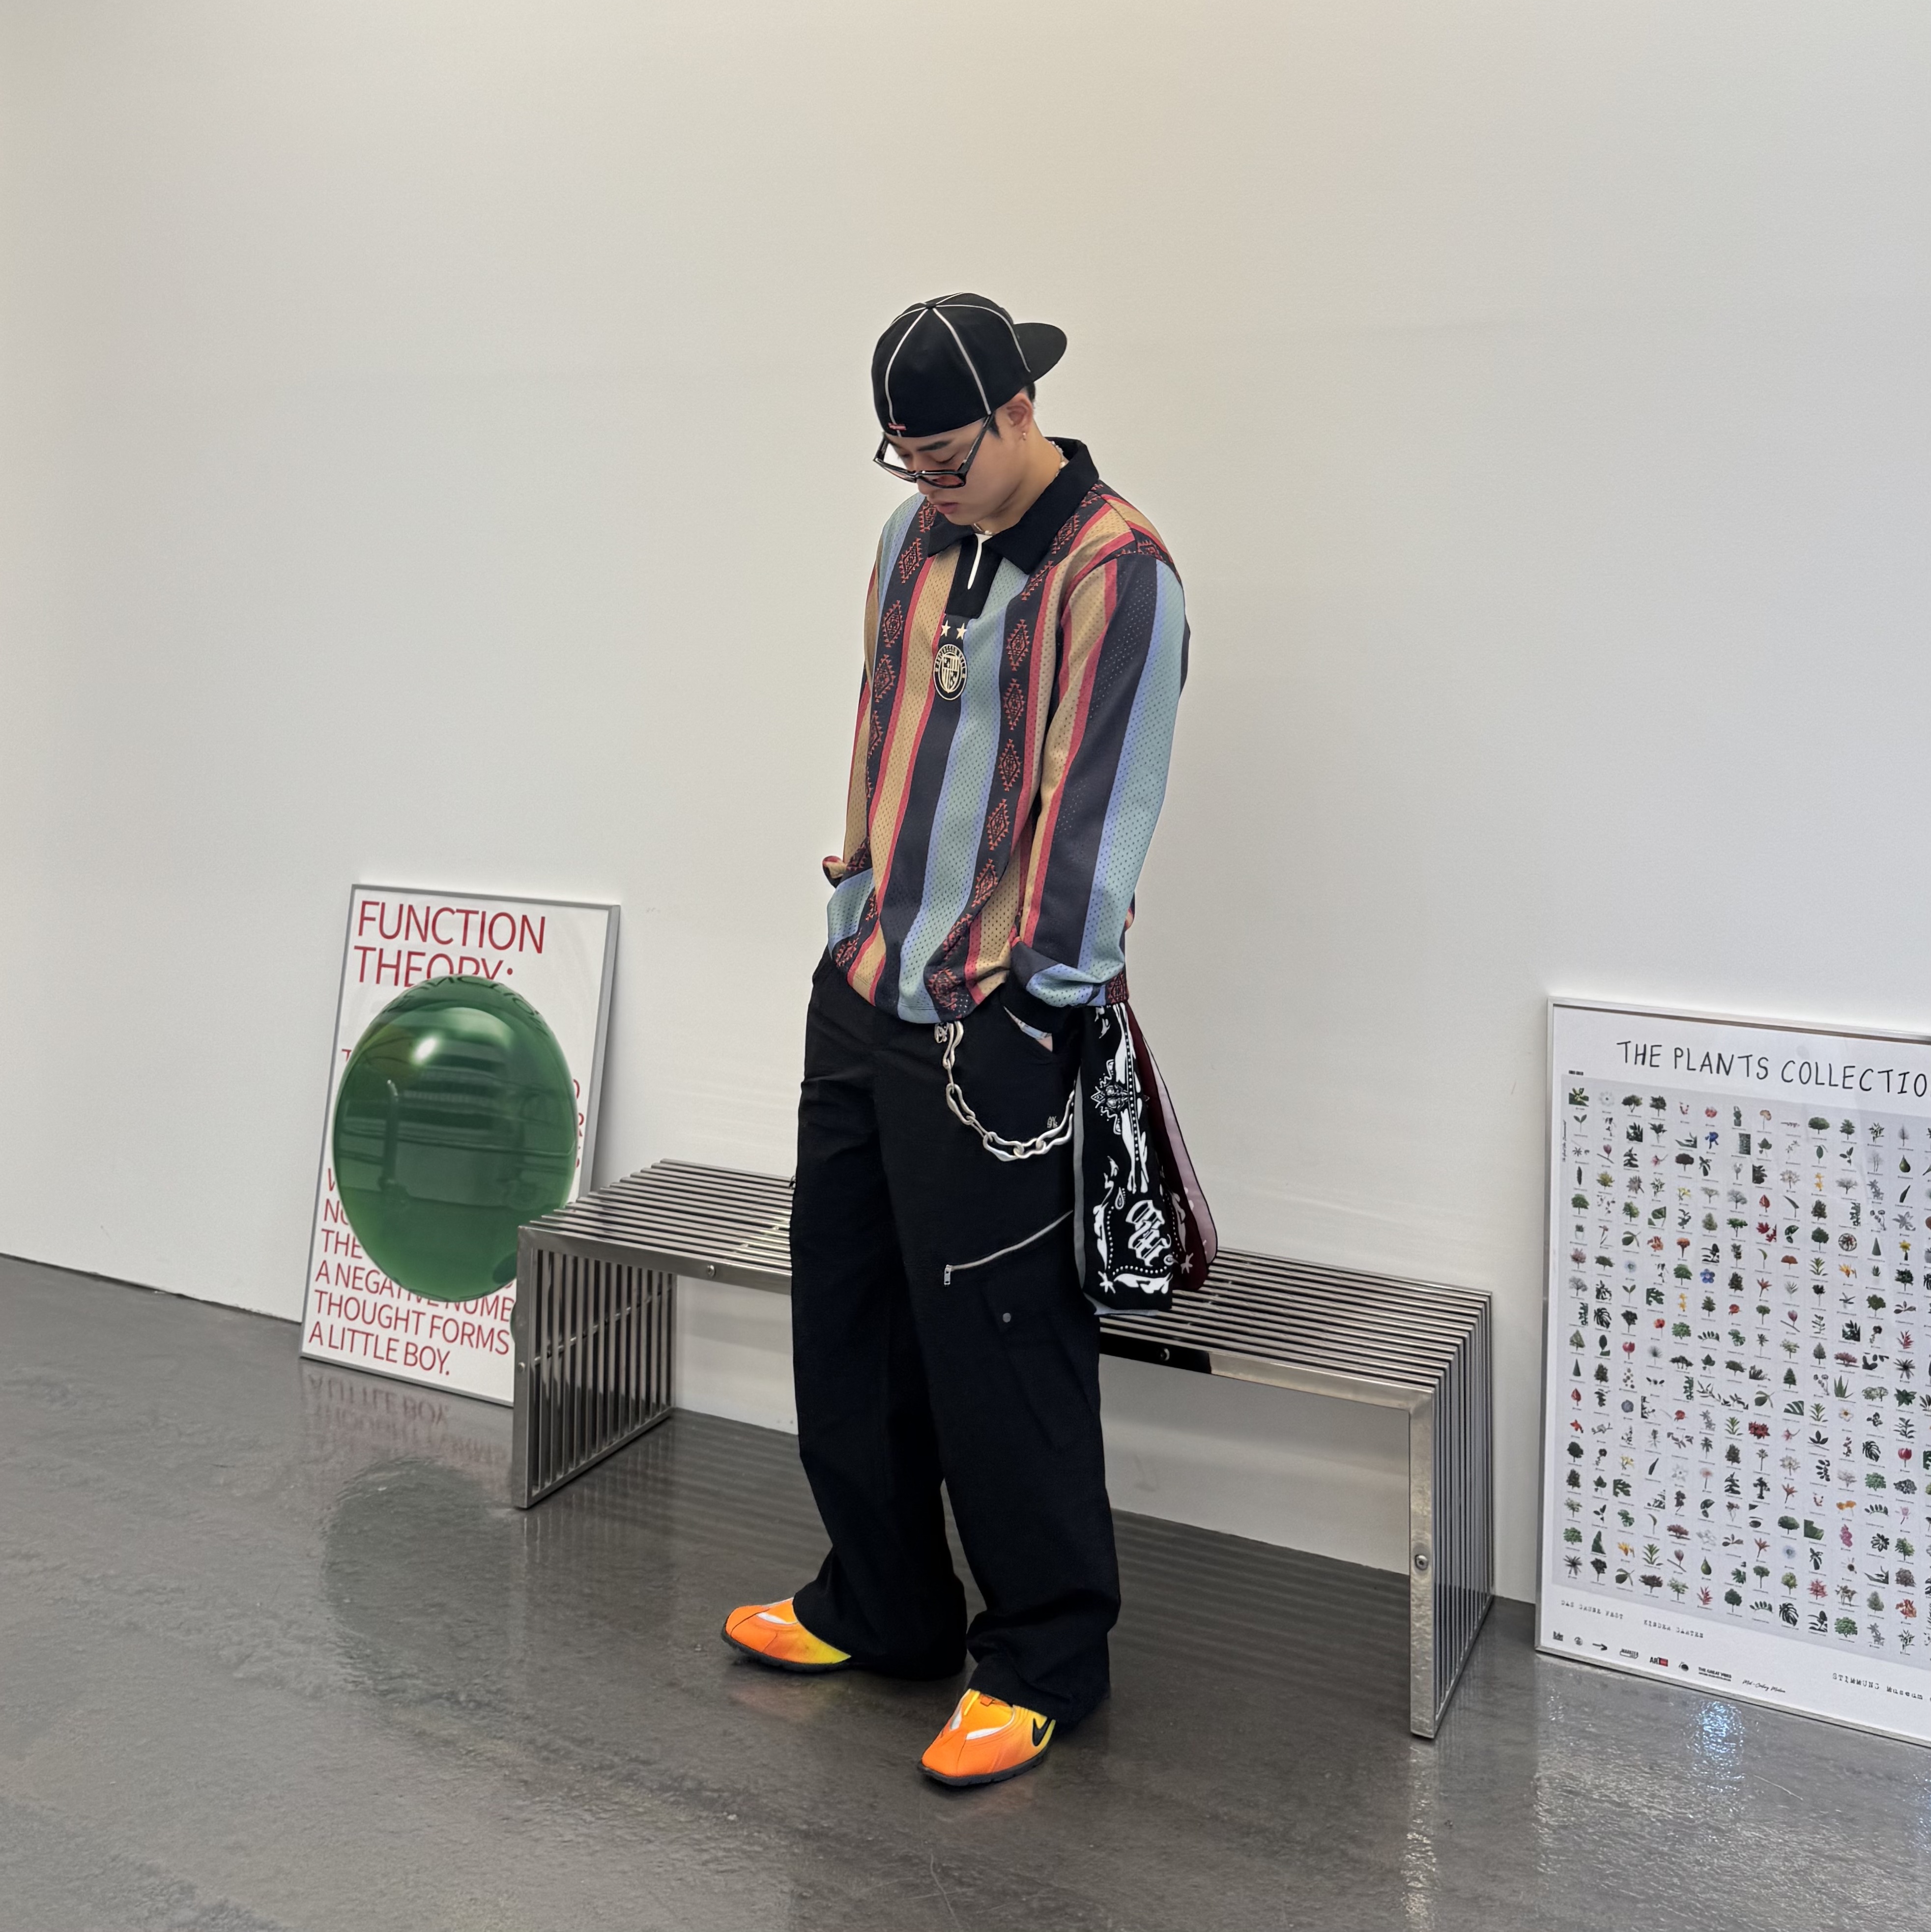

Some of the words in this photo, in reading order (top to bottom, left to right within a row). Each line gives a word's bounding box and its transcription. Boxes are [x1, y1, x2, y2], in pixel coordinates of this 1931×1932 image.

[358, 900, 546, 954] FUNCTION
[1616, 1040, 1662, 1067] THE
[1674, 1047, 1769, 1080] PLANTS
[1781, 1060, 1931, 1097] COLLECTIO
[315, 1260, 330, 1284] A
[308, 1321, 323, 1346] A
[328, 1325, 399, 1363] LITTLE
[403, 1341, 451, 1376] BOY.
[315, 1290, 426, 1335] THOUGHT
[429, 1314, 510, 1355] FORMS
[1886, 1685, 1923, 1700] Museum
